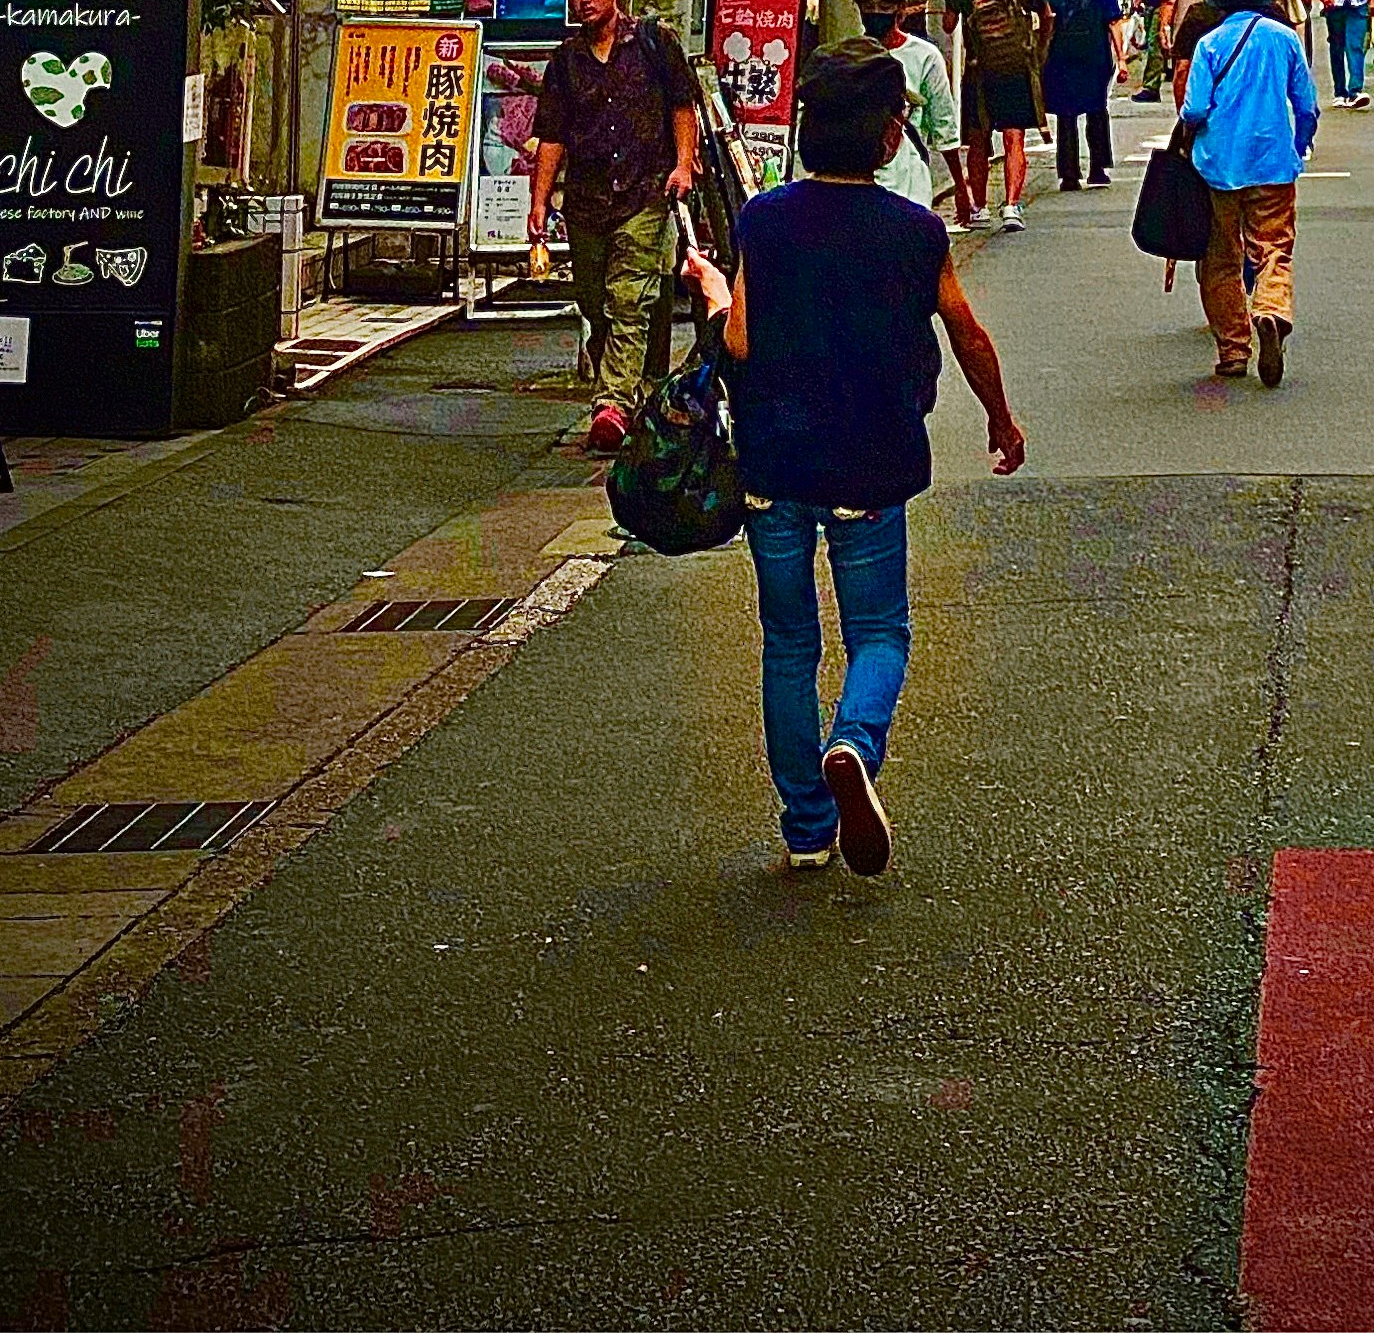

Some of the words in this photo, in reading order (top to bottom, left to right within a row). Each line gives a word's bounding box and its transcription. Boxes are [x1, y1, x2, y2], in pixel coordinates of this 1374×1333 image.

[438, 37, 460, 58] 新
[417, 64, 465, 177] 豚焼肉
[79, 207, 111, 220] AND
[136, 329, 160, 338] Uber
